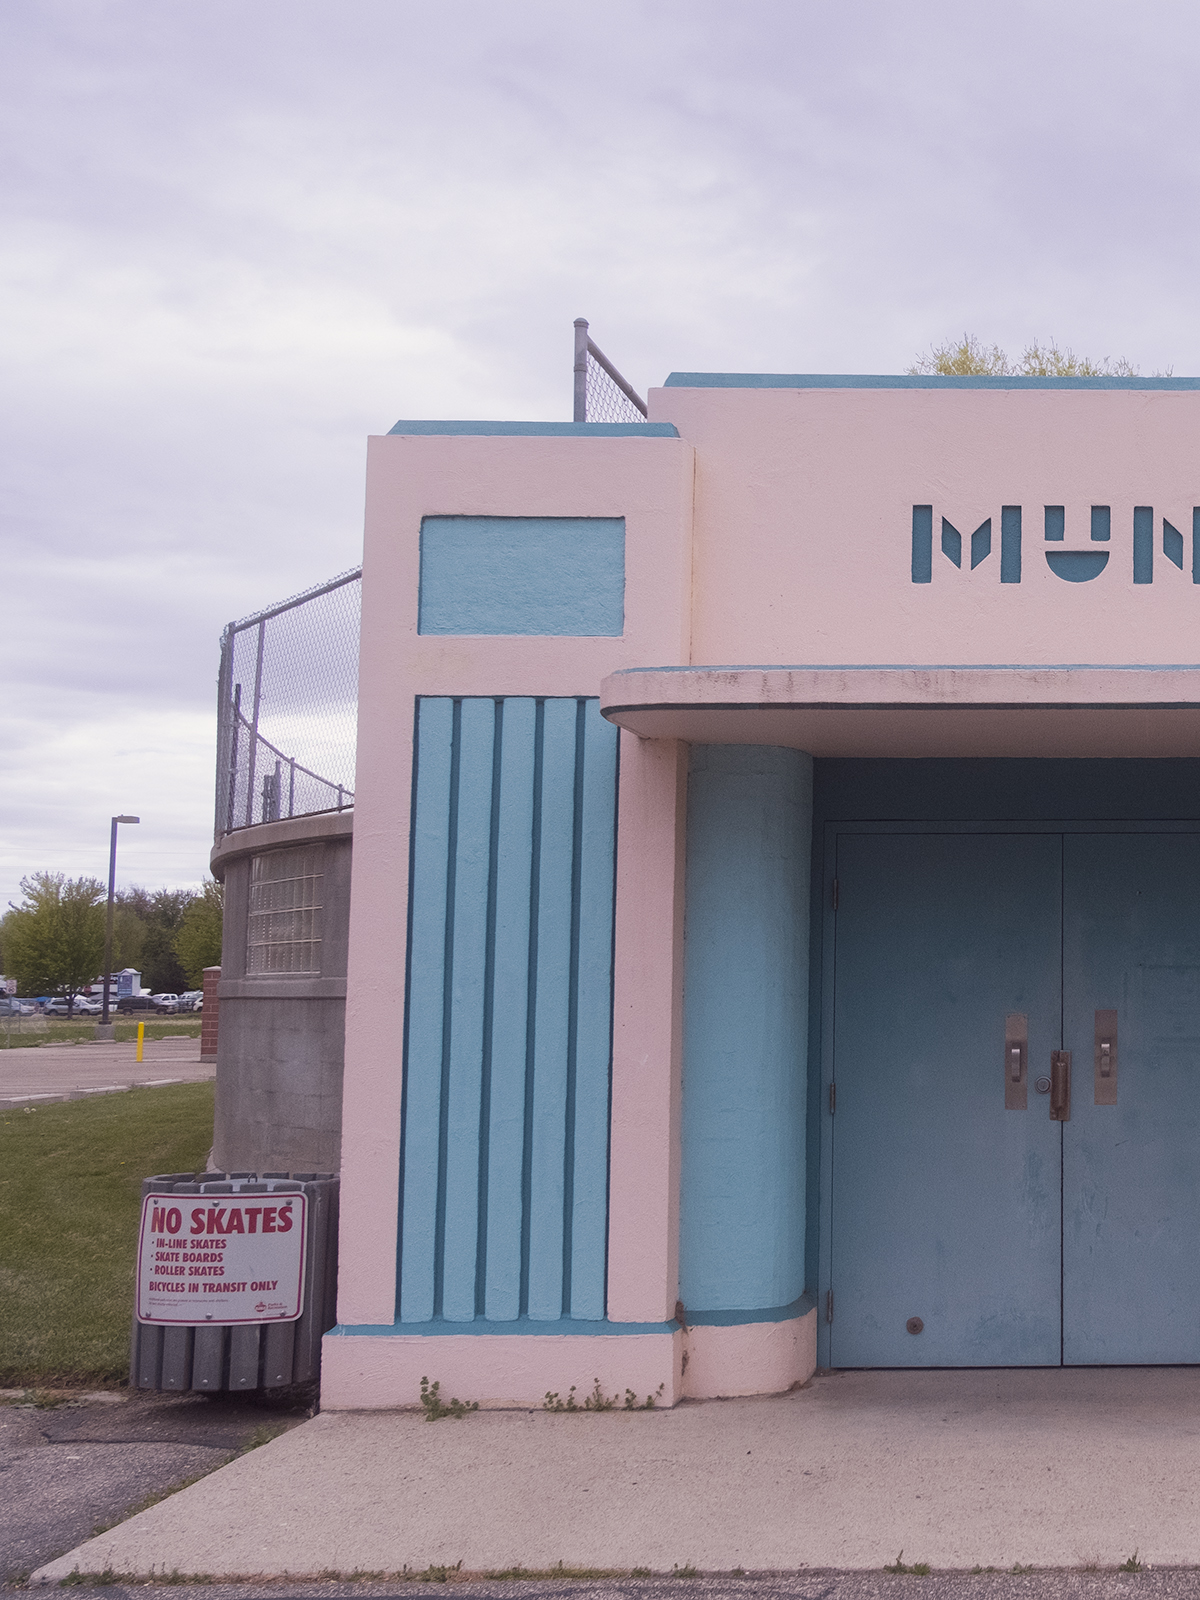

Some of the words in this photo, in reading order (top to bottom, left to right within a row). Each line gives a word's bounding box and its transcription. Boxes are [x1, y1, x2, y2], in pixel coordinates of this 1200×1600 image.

[151, 1207, 182, 1234] NO
[190, 1206, 293, 1234] SKATES
[156, 1238, 187, 1249] IN-LINE
[190, 1239, 227, 1249] SKATES
[155, 1252, 180, 1262] SKATE
[182, 1252, 223, 1263] BOARDS
[154, 1265, 185, 1276] ROLLER
[188, 1266, 225, 1276] SKATES
[149, 1281, 185, 1293] BICYCLES
[188, 1283, 199, 1293] IN
[202, 1282, 247, 1293] TRANSIT
[251, 1280, 278, 1292] ONLY
